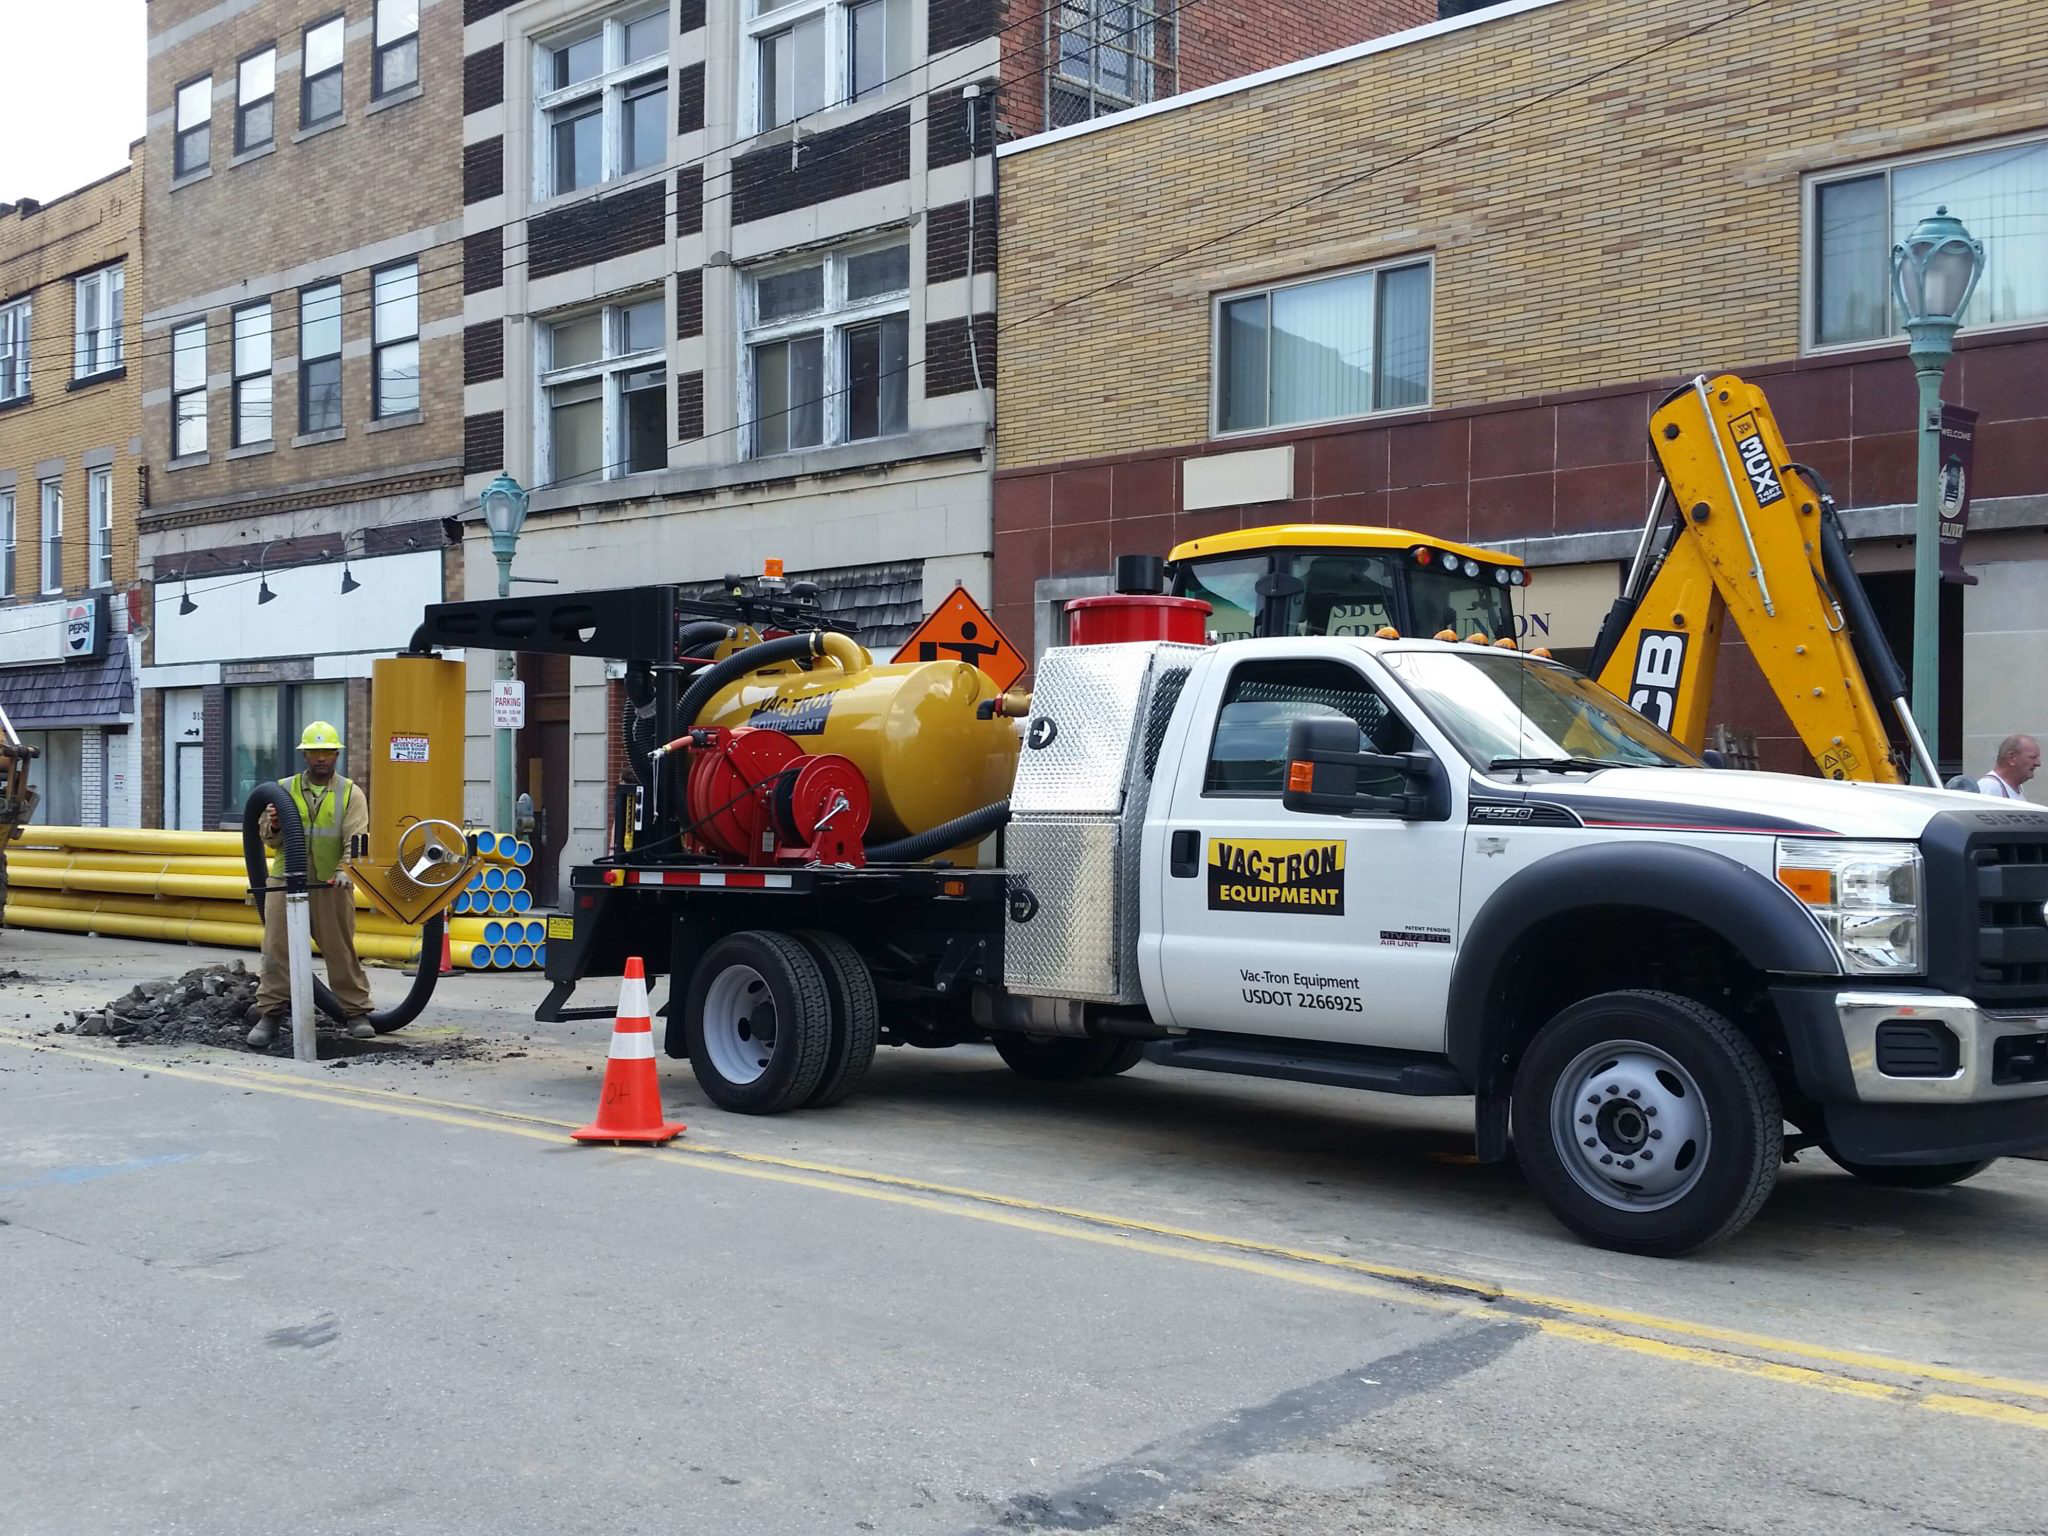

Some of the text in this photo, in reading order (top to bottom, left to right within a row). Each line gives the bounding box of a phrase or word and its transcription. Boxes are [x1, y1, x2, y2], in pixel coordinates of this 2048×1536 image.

[1941, 428, 1972, 441] WELCOME
[1740, 436, 1780, 495] 3CX
[1758, 484, 1780, 499] 14FT
[68, 621, 91, 635] PEPSI
[503, 687, 512, 695] NO
[495, 697, 521, 706] PARKING
[752, 719, 823, 731] EQUIPMENT
[1218, 842, 1338, 886] VAC-TRON
[1220, 885, 1339, 906] EQUIPMENT
[1380, 939, 1396, 947] AIR
[1381, 931, 1450, 943] HTV 373 PTO
[1240, 969, 1361, 989] Vac-Tron Equipment
[1242, 989, 1364, 1013] USDOT 2266925
